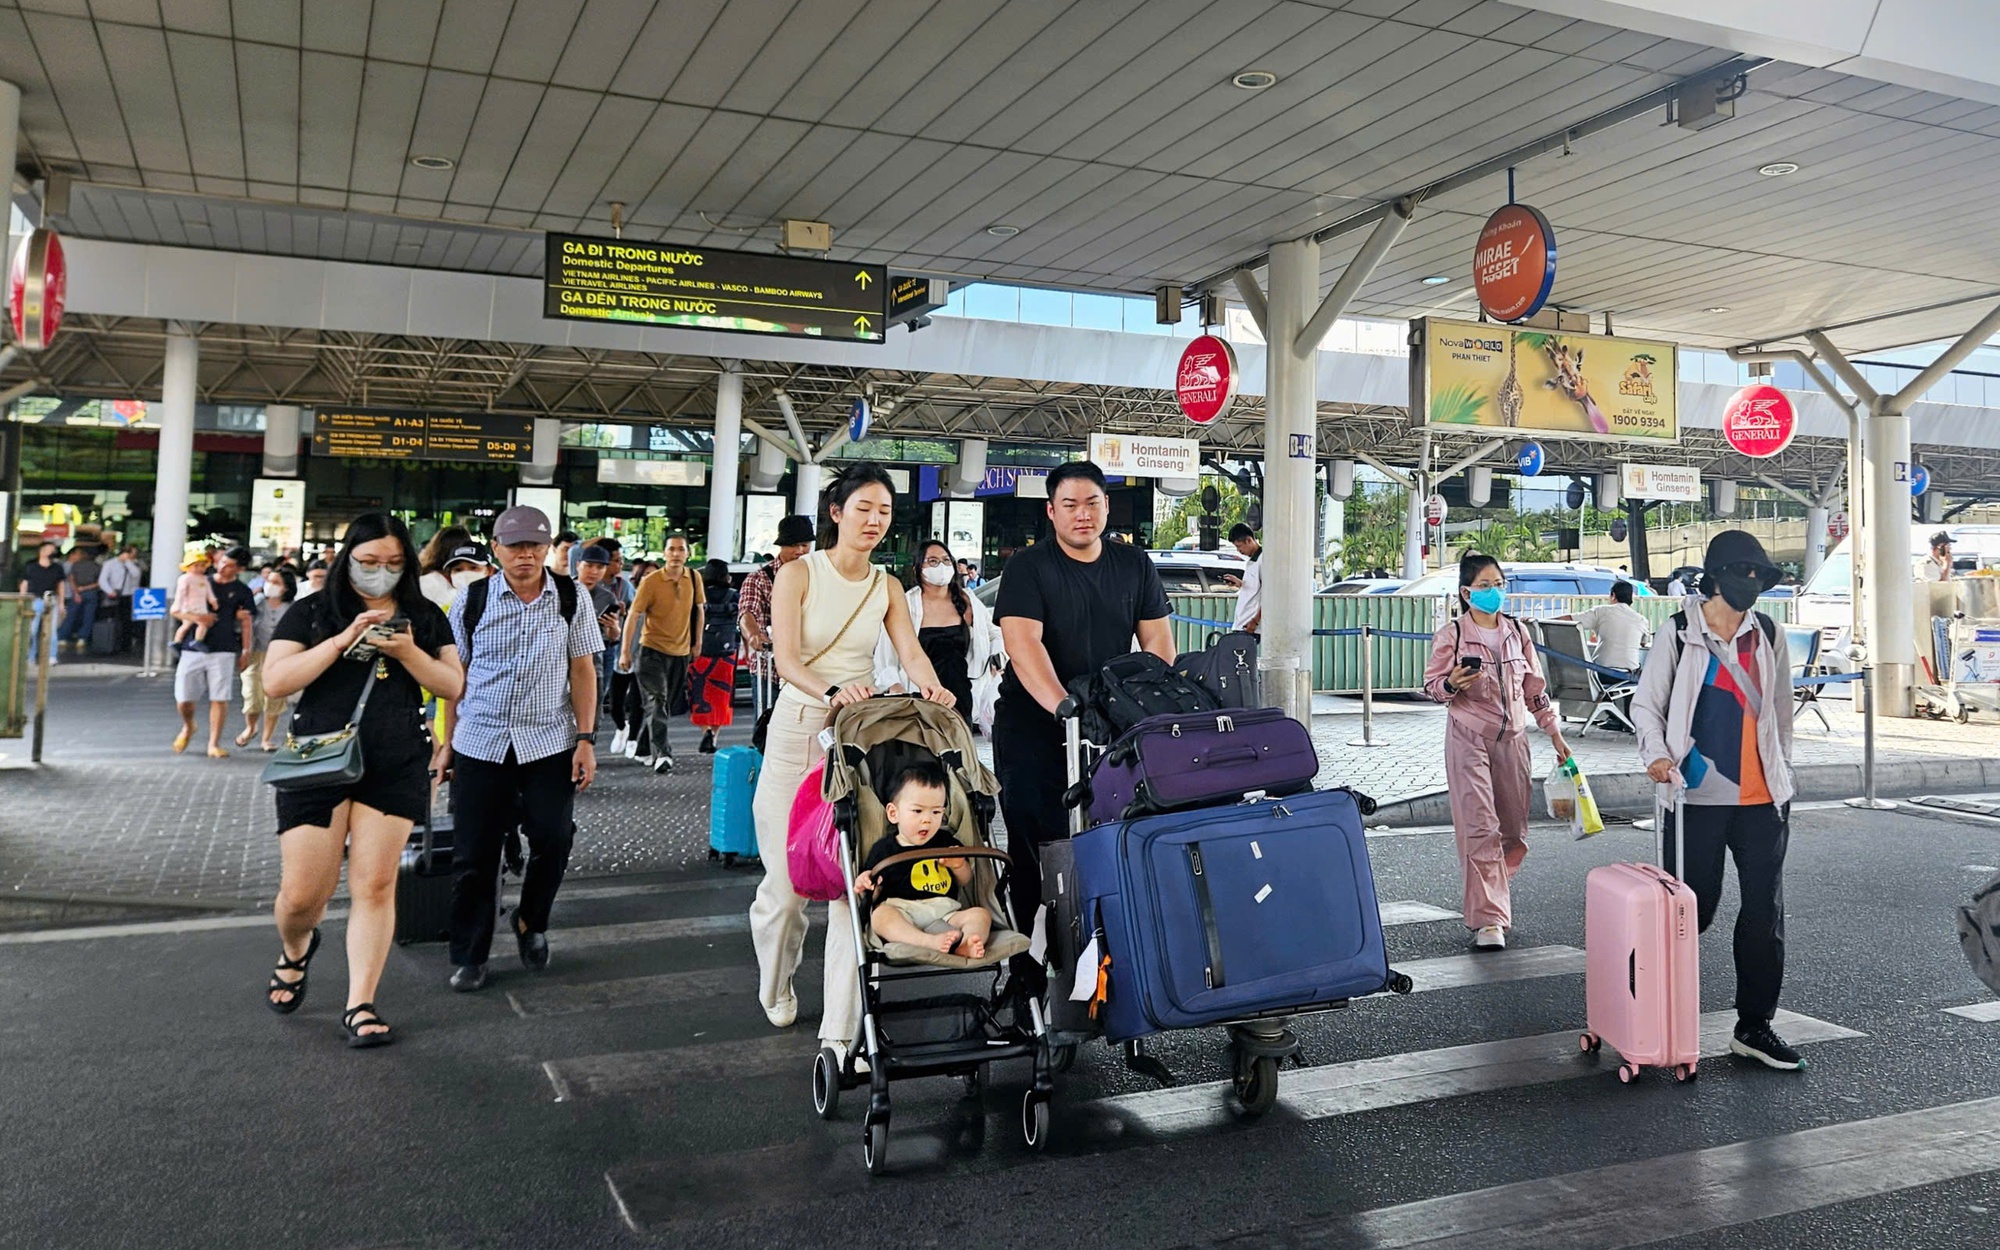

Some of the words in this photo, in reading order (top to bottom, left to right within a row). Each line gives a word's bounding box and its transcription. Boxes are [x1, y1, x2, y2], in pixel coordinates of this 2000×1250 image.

[563, 242, 585, 255] GA
[588, 244, 602, 256] ĐI
[606, 246, 656, 261] TRONG
[661, 249, 703, 266] NƯỚC
[1476, 240, 1512, 270] MIRAE
[562, 256, 613, 268] Domestic
[616, 261, 674, 274] Departures
[1482, 258, 1519, 285] ASSET
[562, 269, 600, 279] VIETNAM
[602, 272, 639, 282] AIRLINES
[646, 277, 676, 286] PACIFIC
[679, 280, 715, 290] AIRLINES
[721, 283, 748, 293] VASCO
[754, 287, 788, 296] BAMBOO
[788, 289, 823, 300] AIRWAYS
[562, 278, 608, 288] VIETRAVEL
[610, 282, 647, 291] AIRLINES
[561, 291, 582, 303] GA
[586, 292, 616, 306] ĐẾN
[620, 295, 670, 310] TRONG
[674, 299, 716, 314] NƯỚC
[560, 304, 611, 317] Domestic
[1619, 381, 1652, 396] Safari
[1179, 390, 1217, 404] GENERALI
[394, 418, 424, 427] A1-A3
[1613, 415, 1637, 425] 1900
[1640, 417, 1665, 428] 9394
[392, 437, 422, 446] D1-D4
[1732, 430, 1780, 440] GENERALI
[487, 442, 516, 451] D5-D8
[1132, 443, 1189, 457] Homtamin
[1137, 457, 1184, 471] Ginseng
[1652, 471, 1693, 483] Homtamin
[1656, 483, 1690, 495] Ginseng
[922, 880, 948, 891] drew
